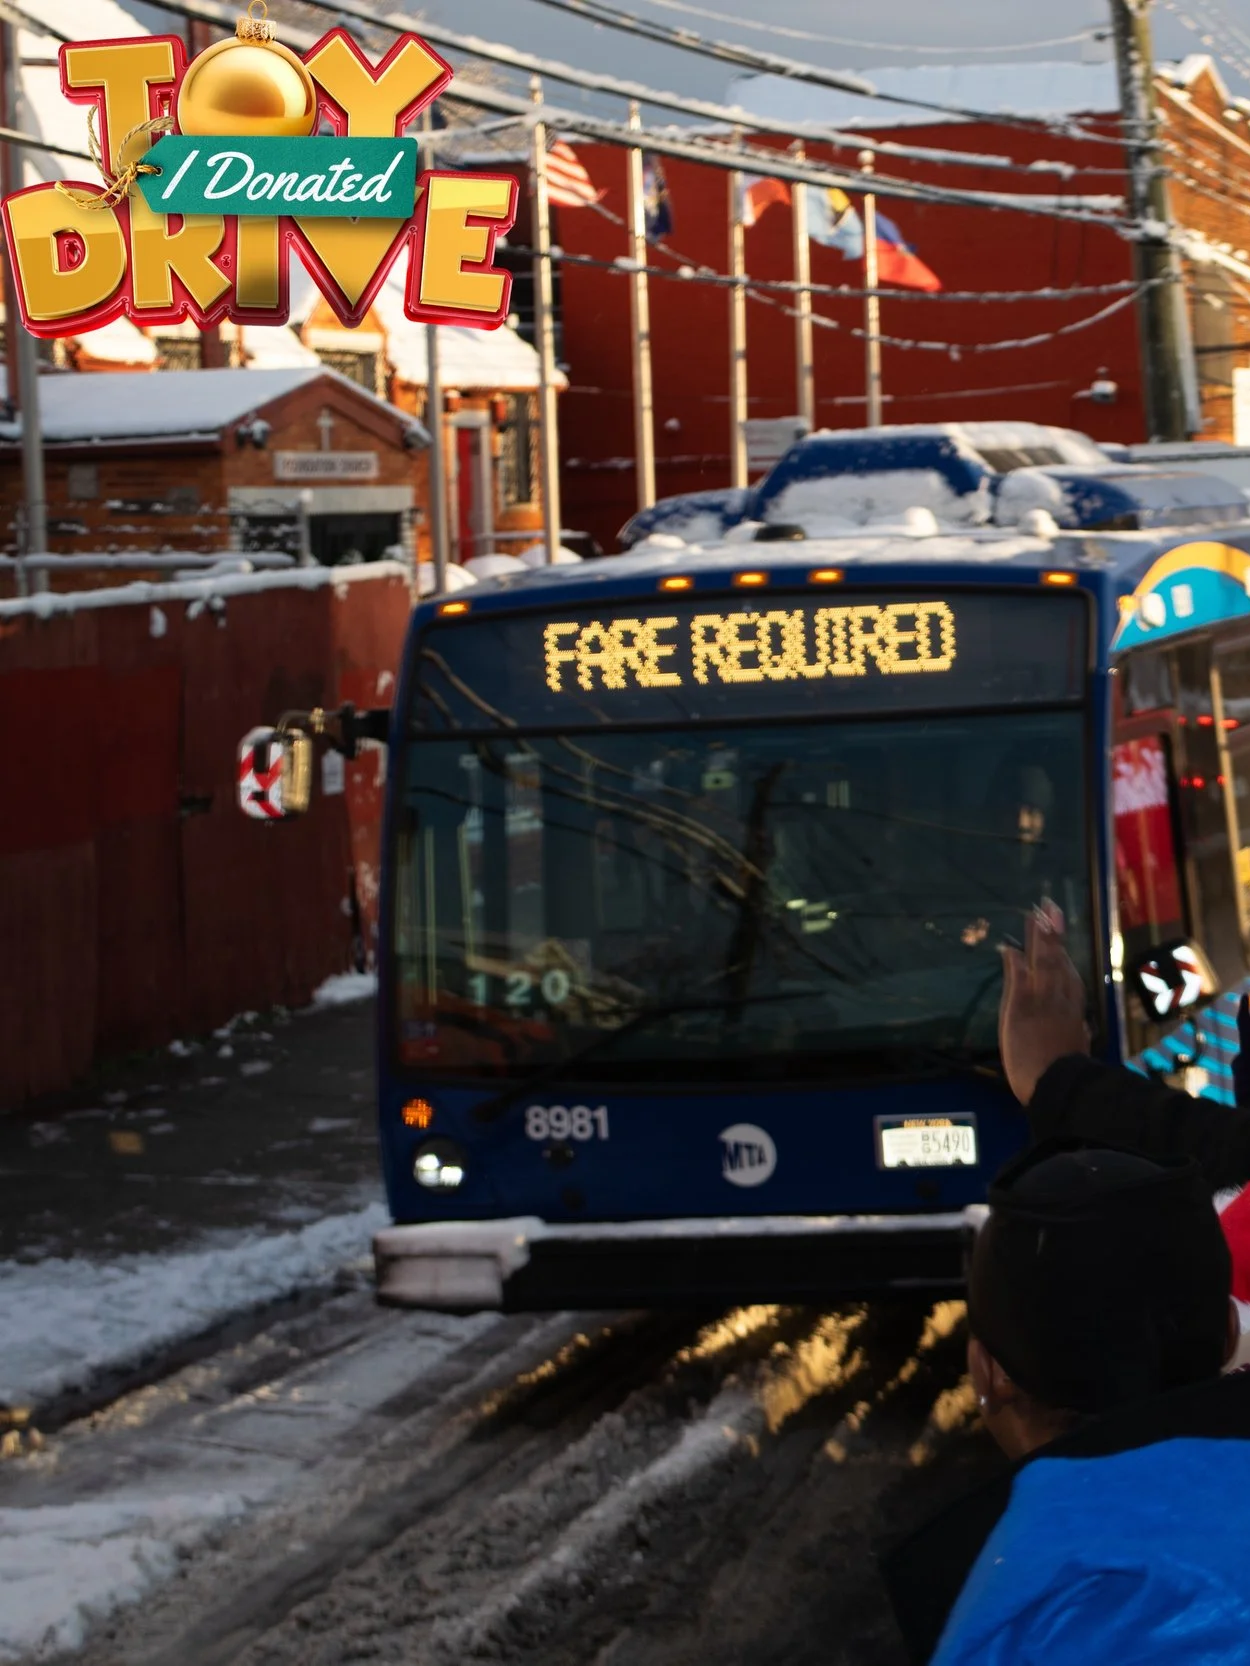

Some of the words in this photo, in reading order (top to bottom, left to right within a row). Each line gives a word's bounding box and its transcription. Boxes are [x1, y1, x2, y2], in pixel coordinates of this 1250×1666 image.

[544, 615, 683, 692] FARE
[690, 601, 957, 685] REQUIRED
[524, 1105, 610, 1141] 8981
